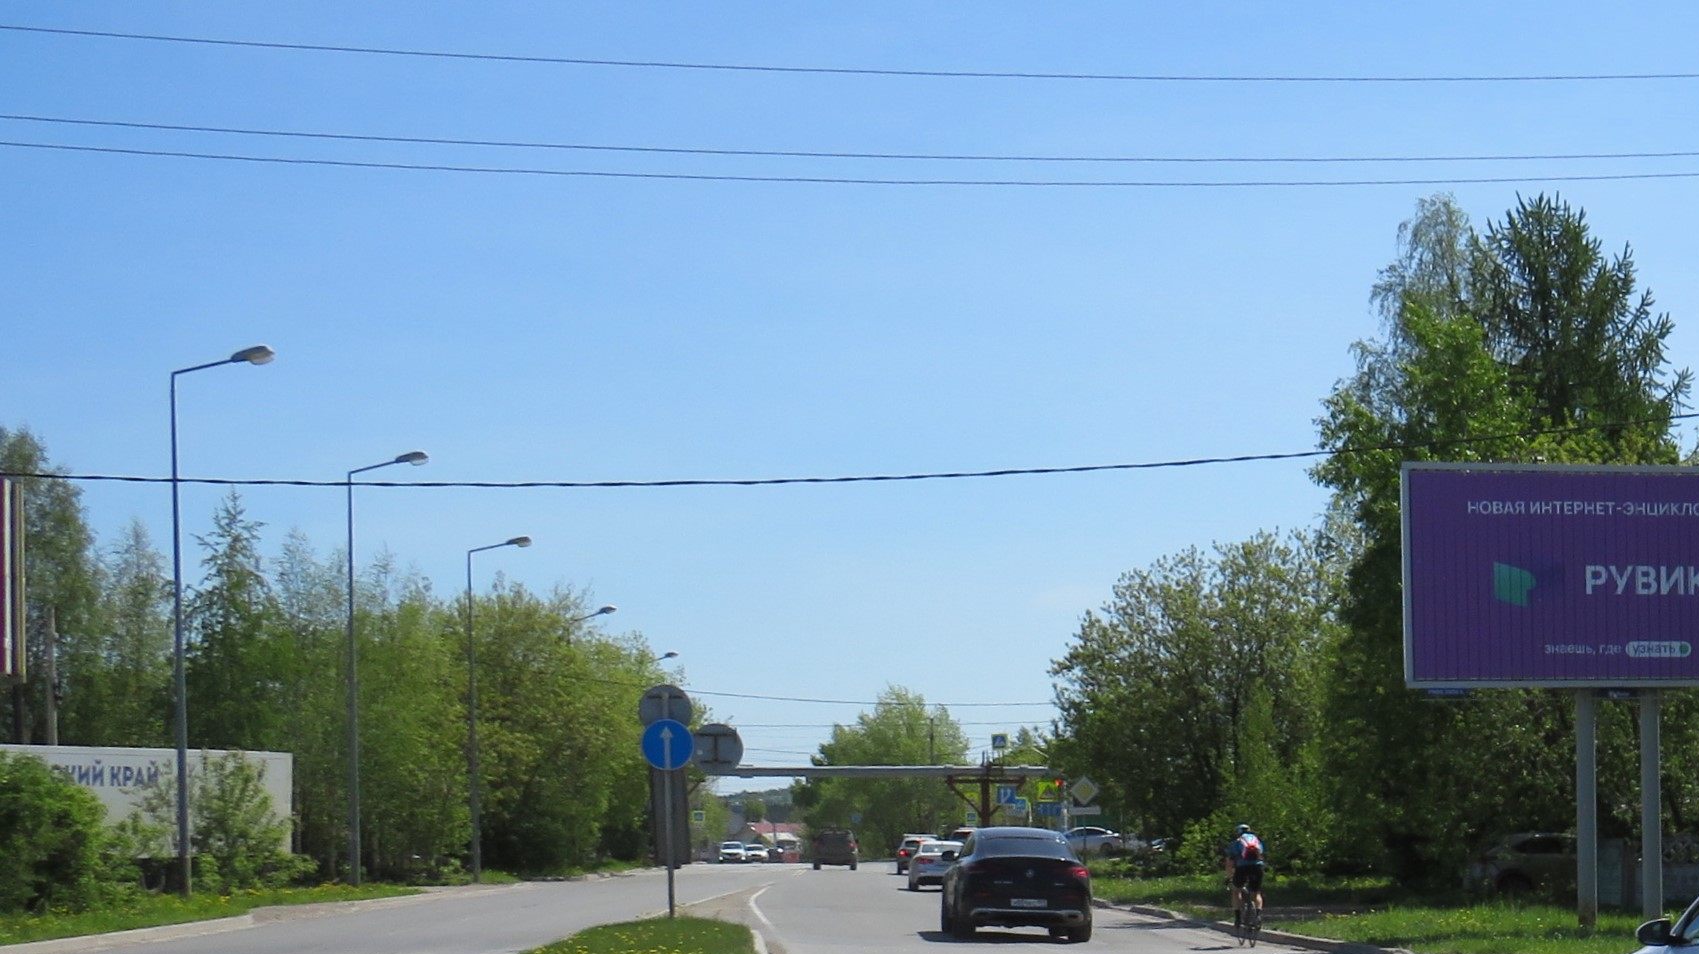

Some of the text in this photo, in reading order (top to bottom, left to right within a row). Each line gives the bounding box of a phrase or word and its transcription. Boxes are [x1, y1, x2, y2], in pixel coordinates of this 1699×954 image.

[1467, 501, 1525, 515] НОВАЯ
[1599, 644, 1622, 655] где
[1632, 644, 1676, 656] узнать
[109, 760, 160, 787] КРАЙ
